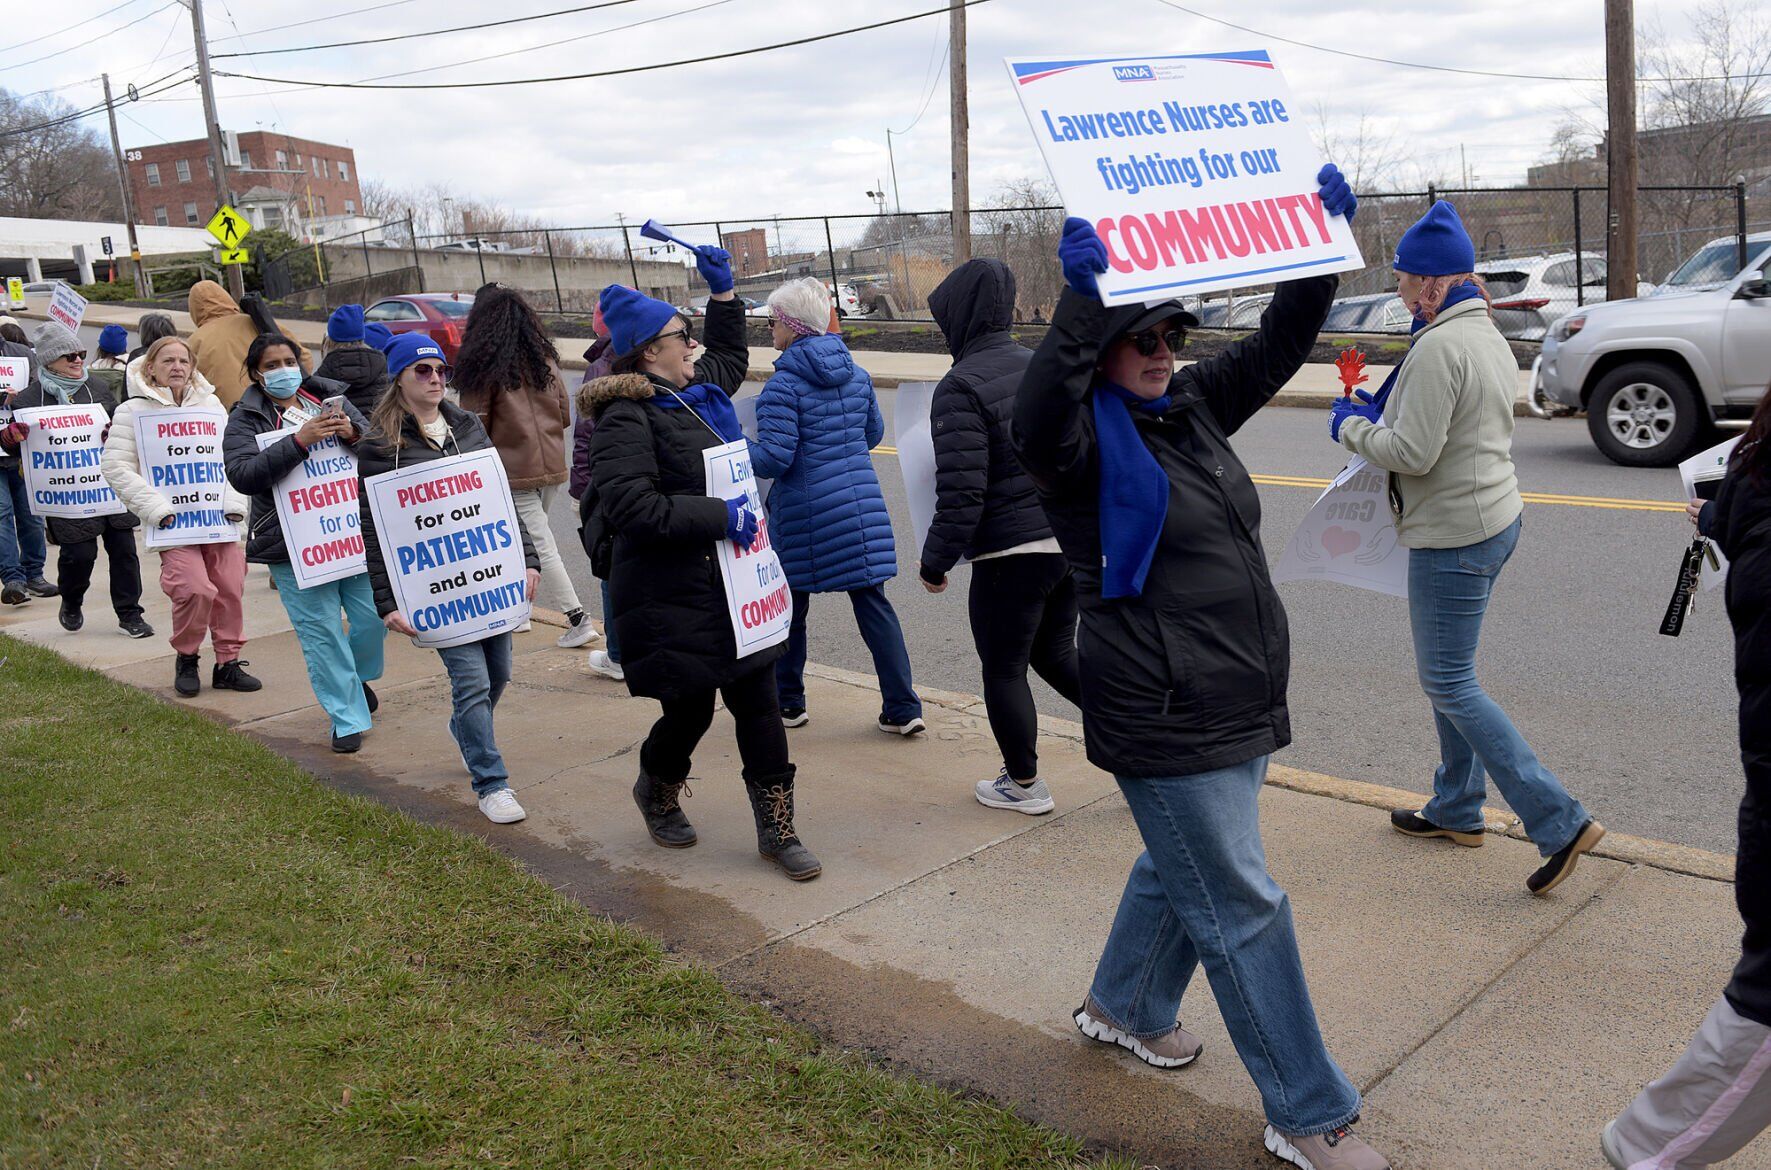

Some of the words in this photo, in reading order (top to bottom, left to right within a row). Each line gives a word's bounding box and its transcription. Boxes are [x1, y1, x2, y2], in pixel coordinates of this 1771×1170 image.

[1114, 67, 1149, 79] MNA
[1041, 107, 1166, 143] Lawrence
[1162, 100, 1249, 133] Nurses
[1247, 97, 1290, 124] are
[127, 150, 143, 162] 38
[1096, 152, 1203, 194] fighting
[1199, 147, 1239, 180] for
[1240, 147, 1282, 176] our
[1095, 191, 1334, 274] COMMUNITY
[39, 413, 94, 430] PICKETING
[157, 420, 217, 438] PICKETING
[48, 434, 68, 446] for
[71, 433, 91, 444] our
[167, 444, 191, 457] for
[195, 444, 215, 454] our
[32, 446, 104, 470] PATIENT
[303, 454, 353, 478] Nurses
[48, 474, 76, 486] and
[79, 473, 102, 484] our
[151, 461, 225, 487] PATIENTS
[35, 486, 117, 505] COMMUNITY
[171, 491, 200, 505] and
[204, 491, 220, 502] our
[396, 470, 484, 508] PICKETING
[158, 508, 231, 531] OMMUNIT
[319, 515, 343, 535] for
[414, 511, 445, 531] for
[450, 503, 481, 521] our
[396, 519, 512, 576] PATIENTS
[429, 572, 468, 595] and
[472, 563, 503, 583] our
[756, 563, 770, 588] for
[412, 579, 526, 633] COMMUNITY
